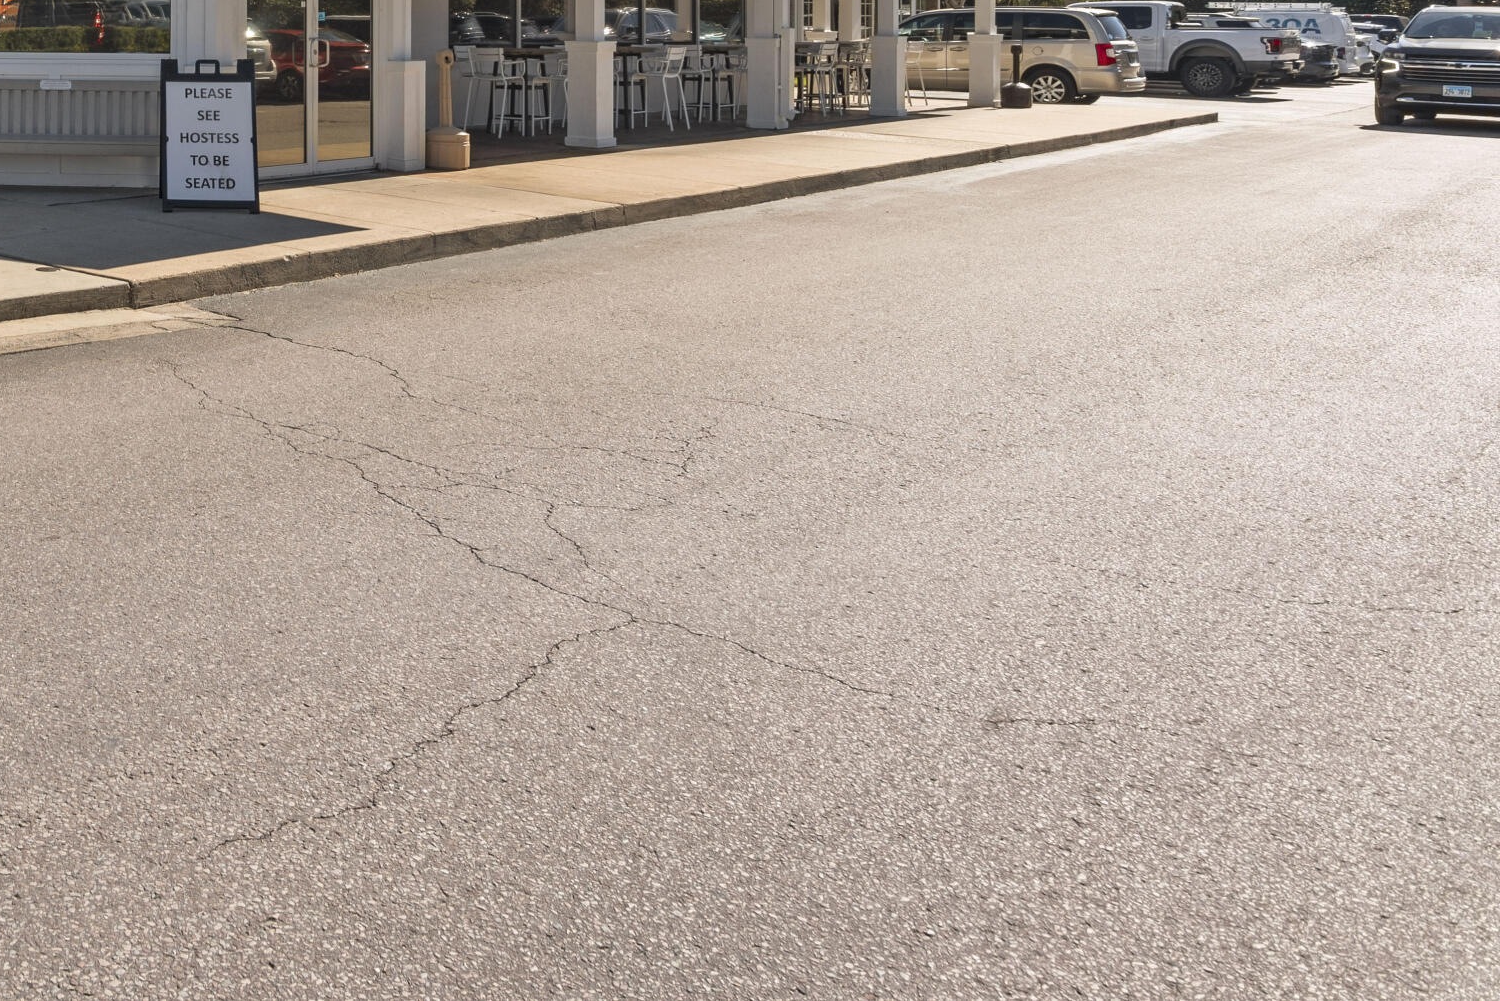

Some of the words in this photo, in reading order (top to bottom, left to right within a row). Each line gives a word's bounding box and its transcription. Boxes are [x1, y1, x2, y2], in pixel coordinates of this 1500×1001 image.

[184, 88, 233, 99] PLEASE
[197, 110, 221, 121] SEE
[180, 132, 240, 144] HOSTESS
[190, 155, 209, 166] TO
[213, 155, 230, 167] BE
[185, 177, 236, 190] SEATED
